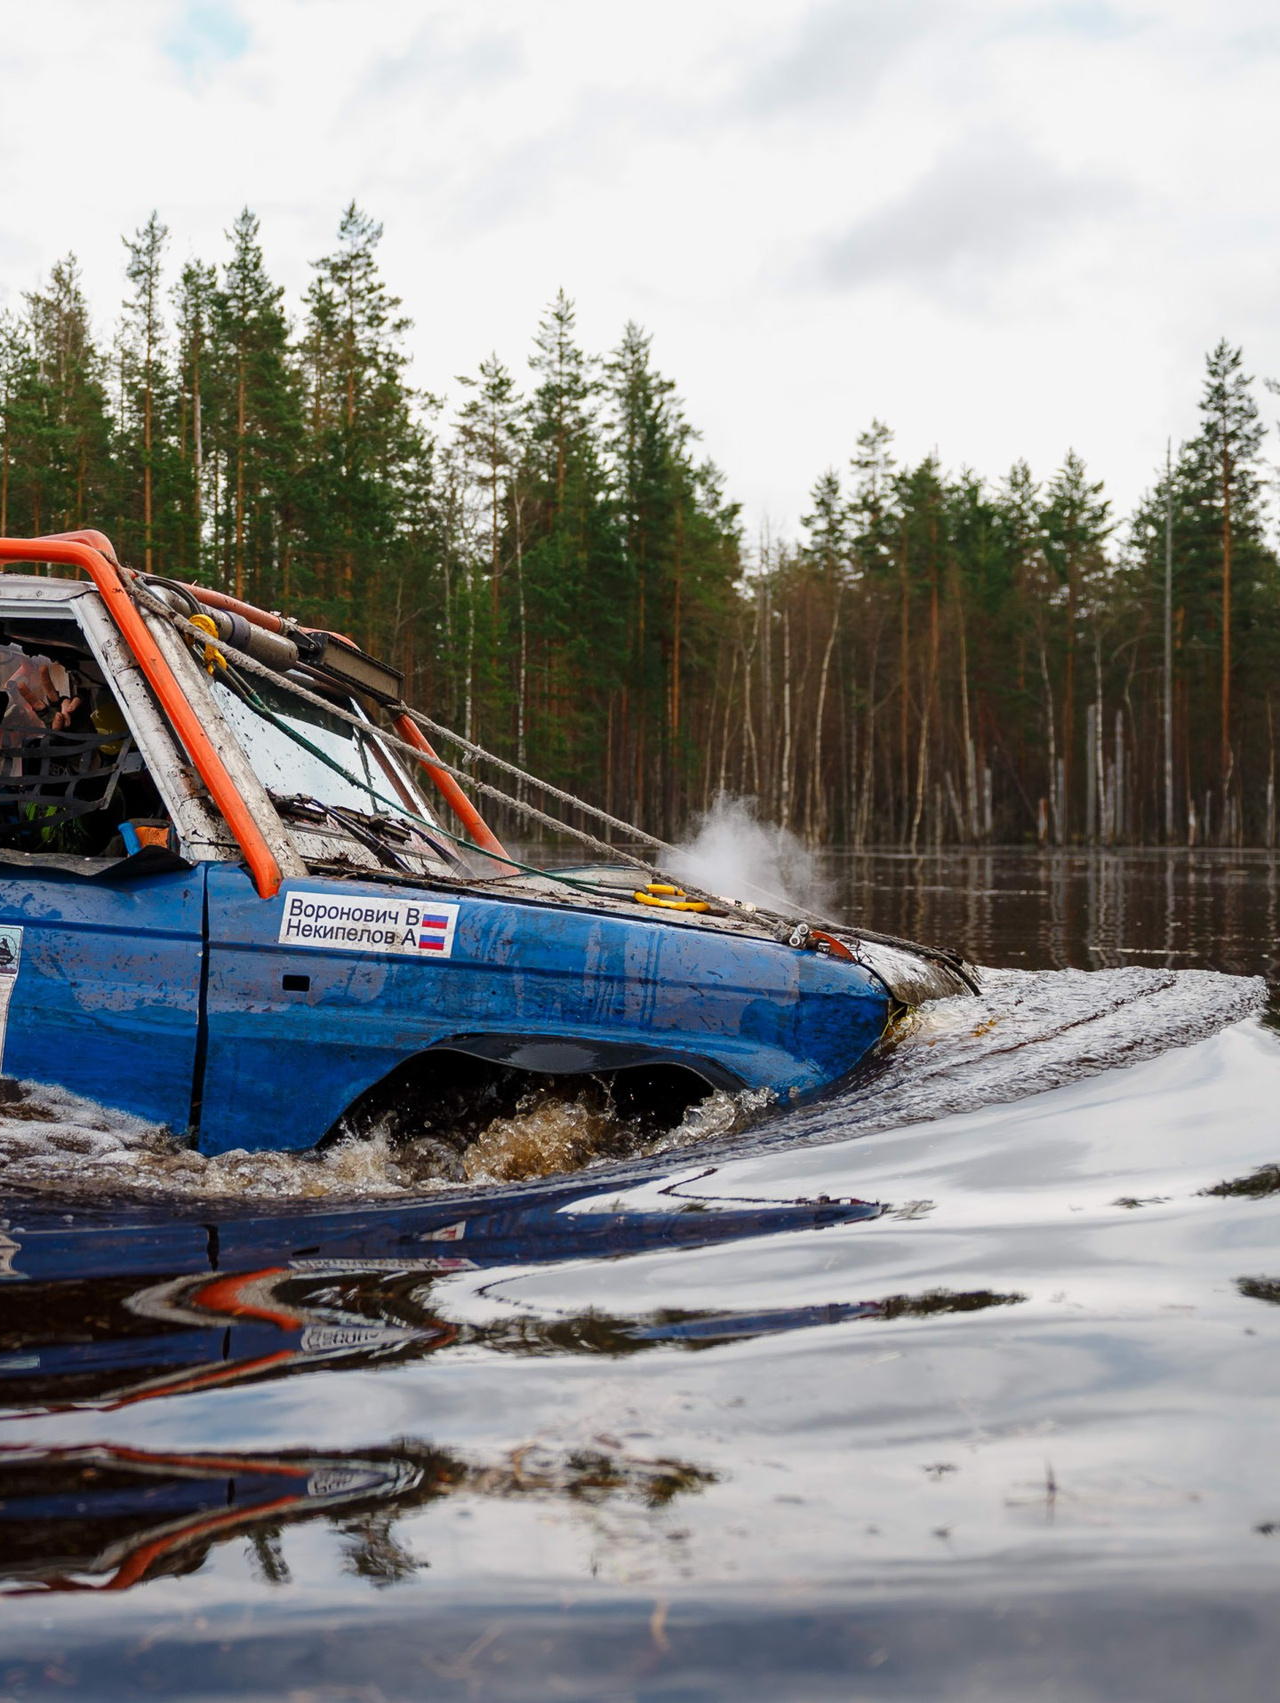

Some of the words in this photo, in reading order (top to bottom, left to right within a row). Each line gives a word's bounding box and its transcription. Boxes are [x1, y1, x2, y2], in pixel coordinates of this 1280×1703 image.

[289, 898, 399, 925] Воронович
[405, 907, 420, 926] В
[286, 918, 396, 945] Некипелов
[401, 928, 417, 947] А
